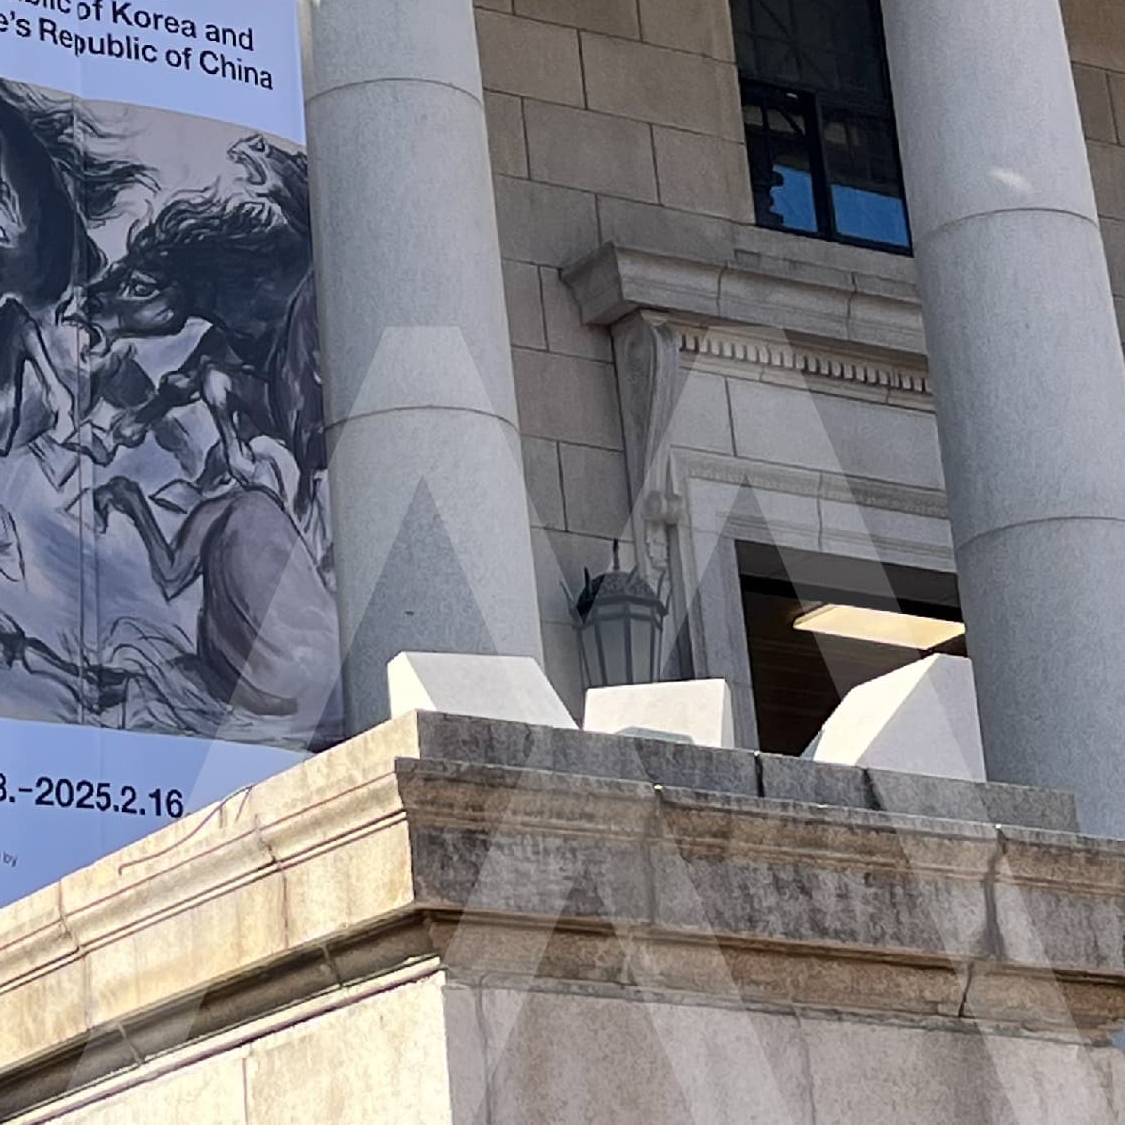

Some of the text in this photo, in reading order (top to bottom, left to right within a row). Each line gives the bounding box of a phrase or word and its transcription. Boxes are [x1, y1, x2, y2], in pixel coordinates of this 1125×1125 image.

[112, 0, 197, 39] Korea
[204, 23, 255, 52] and
[38, 18, 158, 64] Republic
[165, 47, 192, 71] of
[199, 50, 274, 91] China
[2, 850, 18, 868] by
